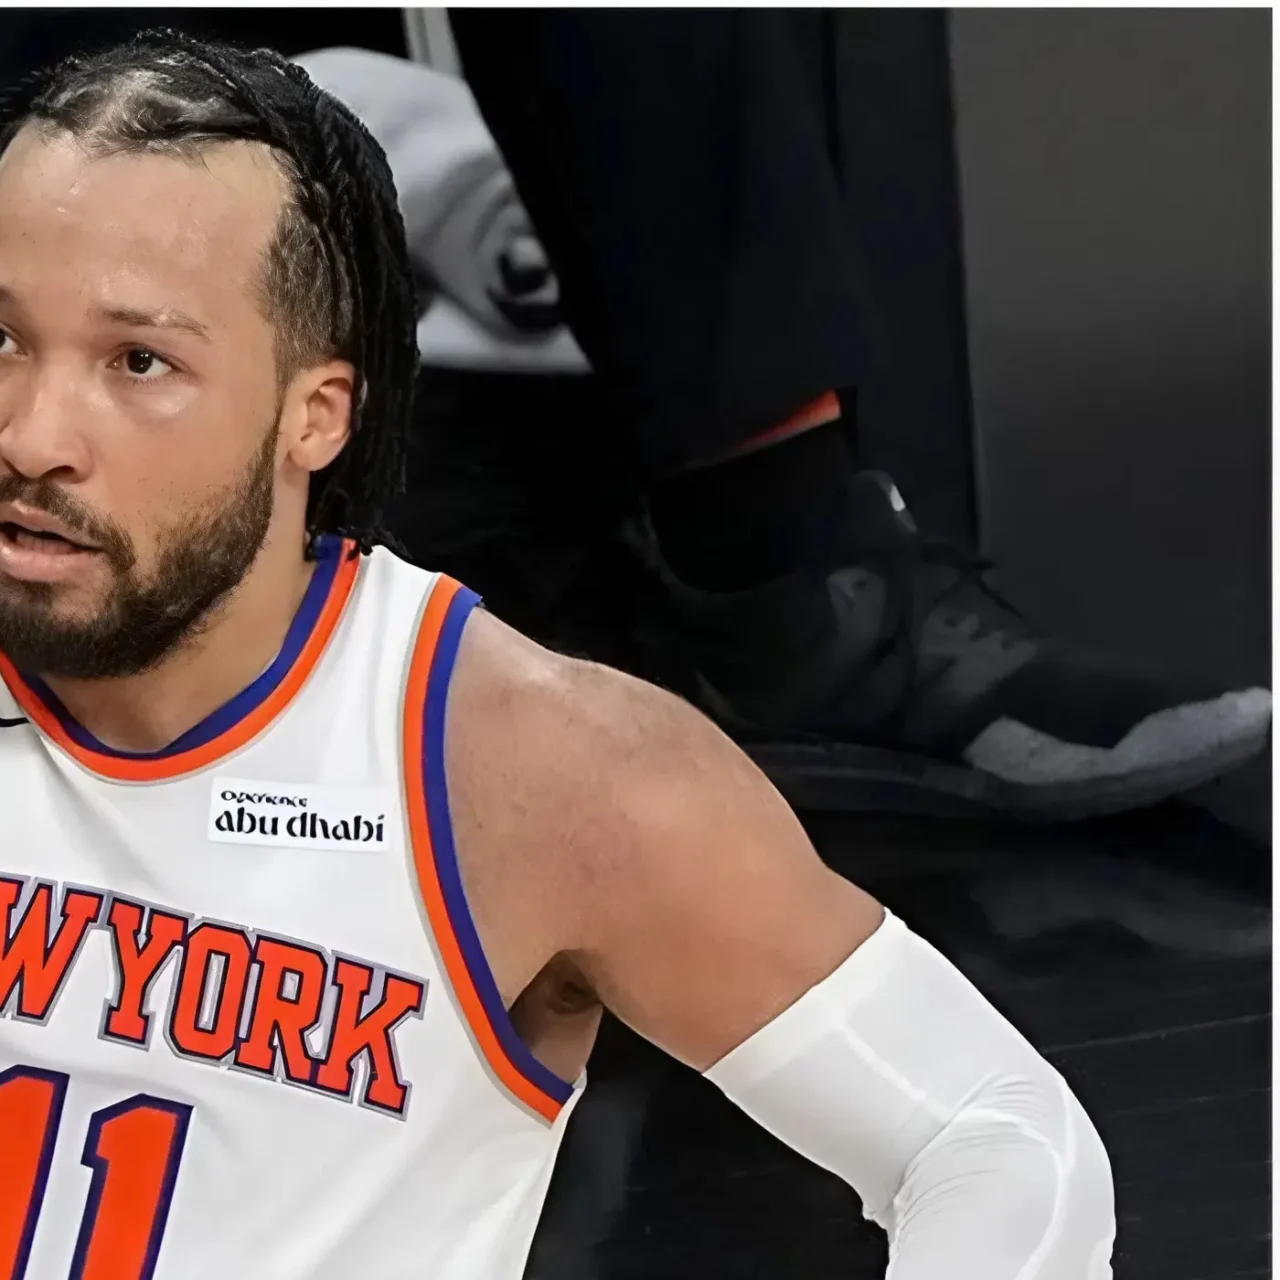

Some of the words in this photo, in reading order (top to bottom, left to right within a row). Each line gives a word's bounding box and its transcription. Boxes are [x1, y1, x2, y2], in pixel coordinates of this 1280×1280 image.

[215, 807, 278, 835] abu
[286, 812, 385, 842] dhabi
[98, 888, 431, 1122] YORK
